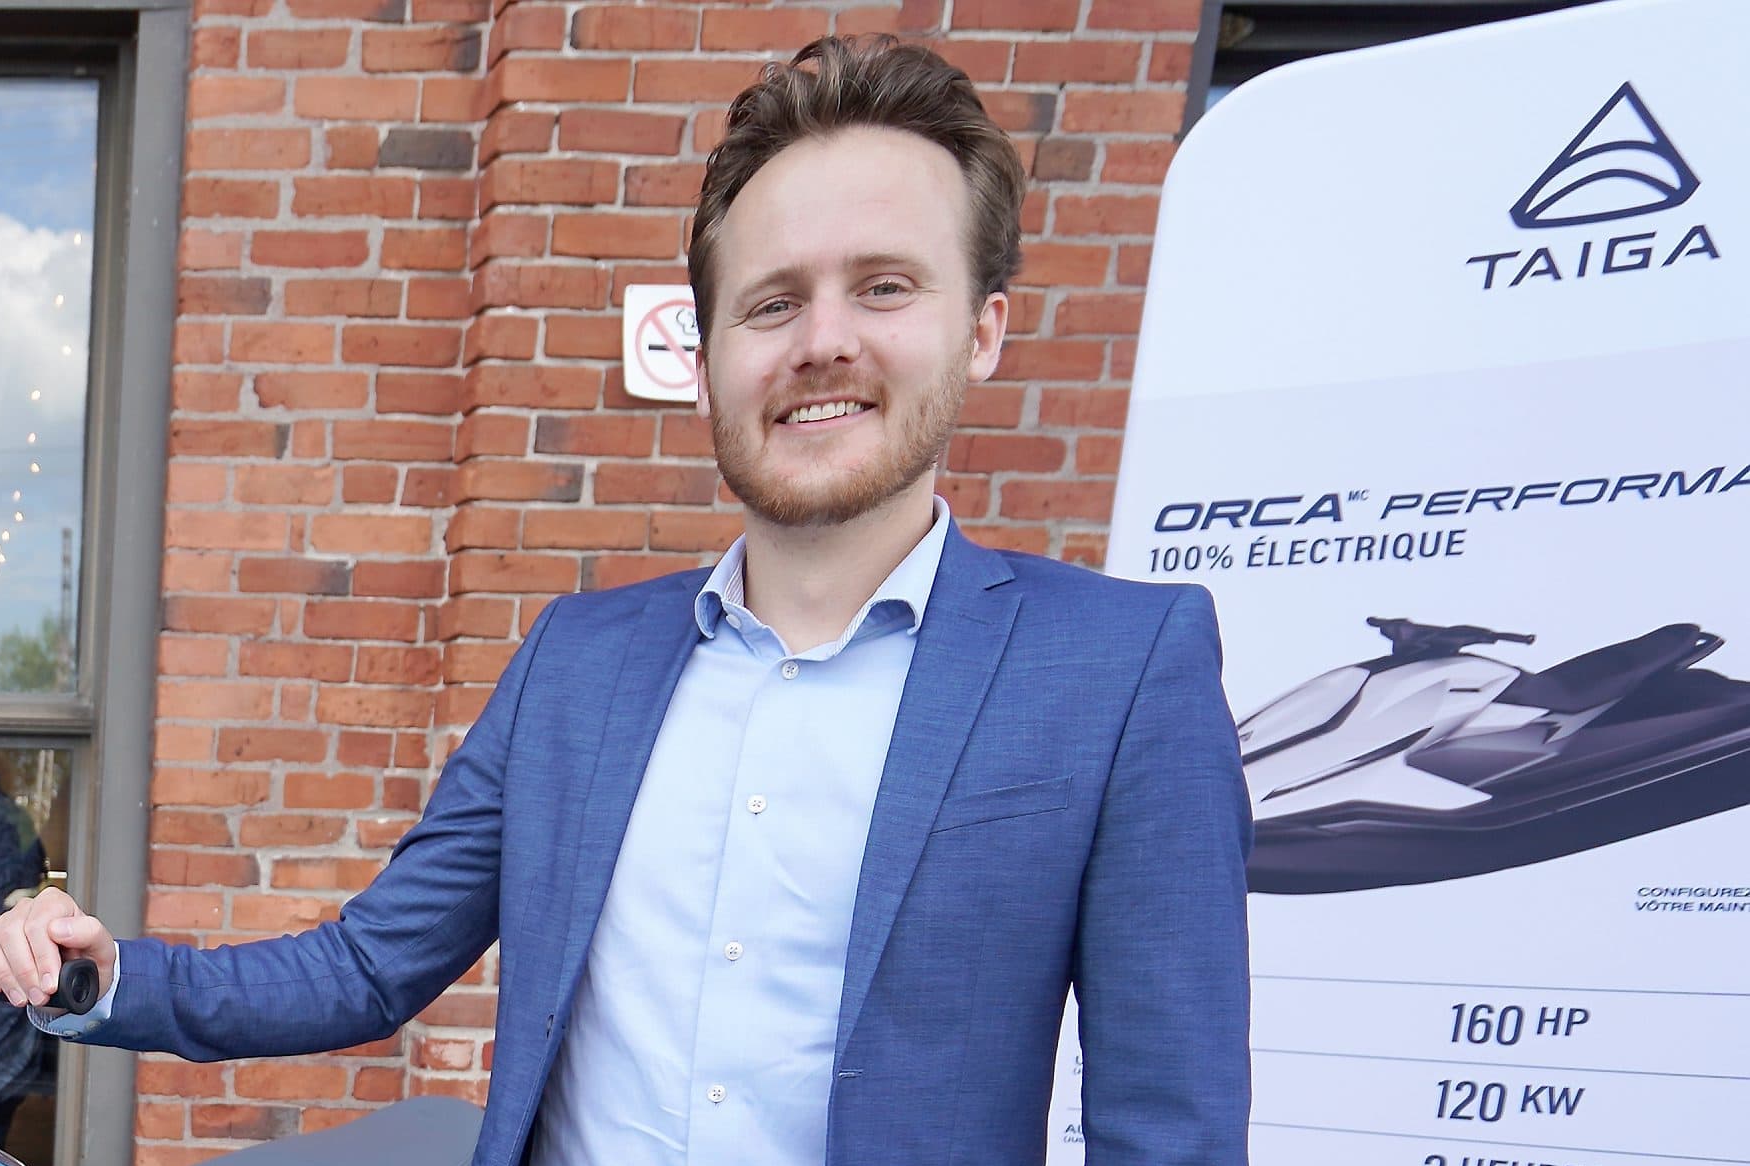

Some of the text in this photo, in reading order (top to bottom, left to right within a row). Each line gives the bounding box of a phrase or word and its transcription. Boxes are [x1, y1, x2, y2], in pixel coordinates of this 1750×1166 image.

[1466, 224, 1721, 290] TAIGA
[1154, 493, 1342, 532] ORCA
[1149, 529, 1468, 573] 100% ÉLECTRIQUE
[1451, 1003, 1591, 1046] 160 HP
[1437, 1080, 1586, 1123] 120 KW
